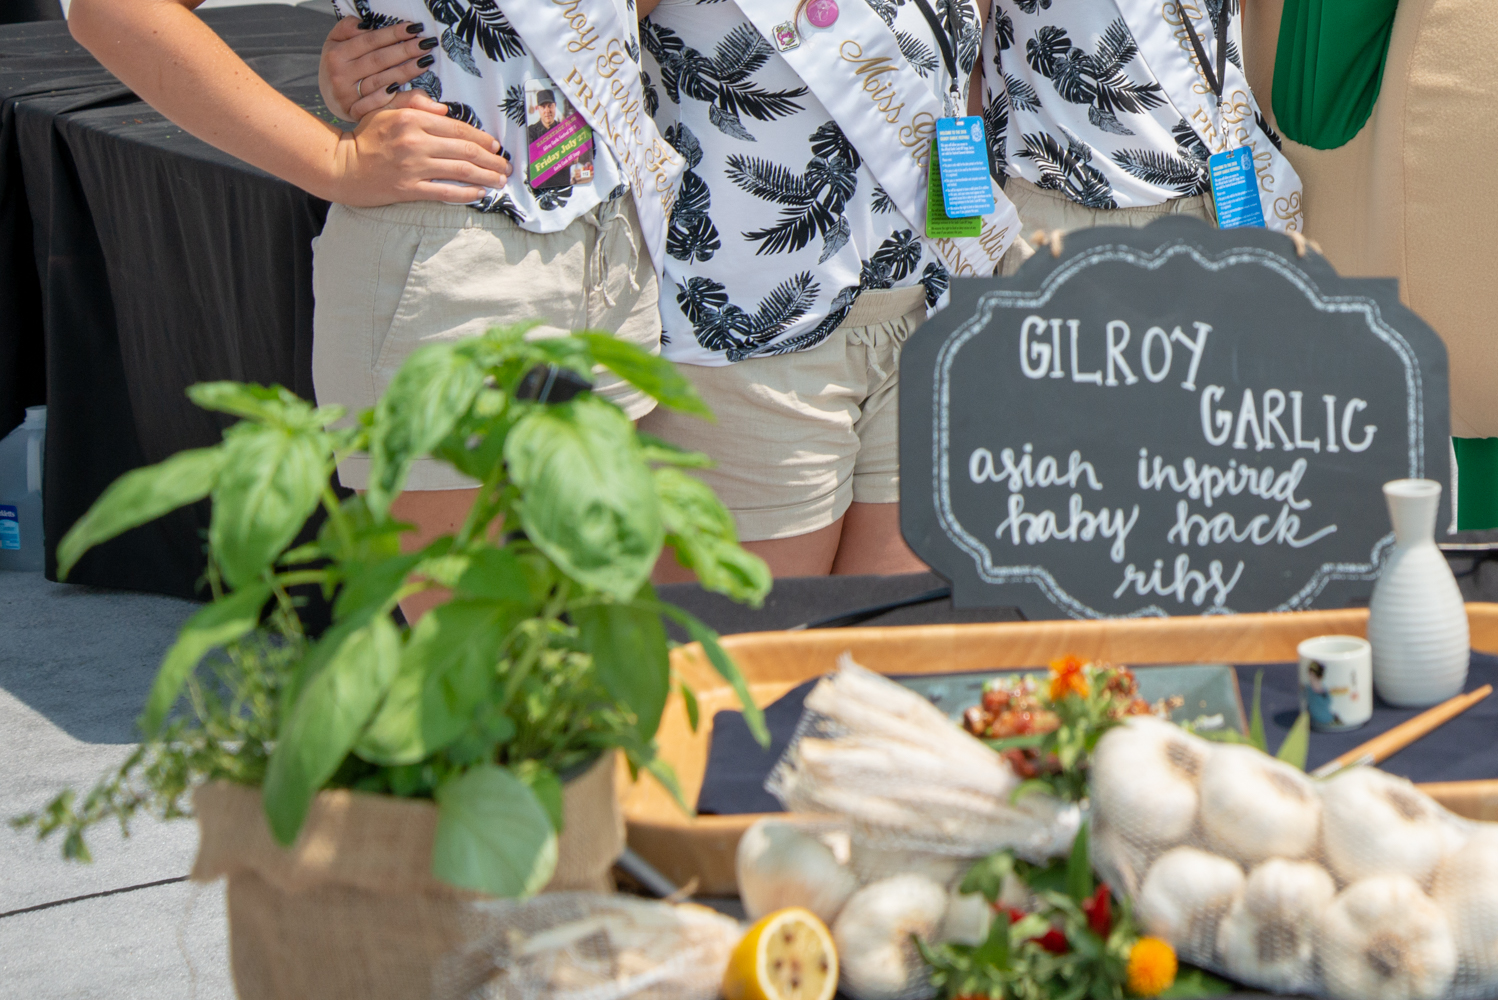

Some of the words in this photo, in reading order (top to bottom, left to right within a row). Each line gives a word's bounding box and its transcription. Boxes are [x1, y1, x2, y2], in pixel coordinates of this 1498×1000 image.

[596, 37, 644, 146] Garlic
[839, 40, 900, 124] Miss
[535, 150, 560, 172] Friday
[560, 137, 577, 154] July
[578, 130, 587, 141] 27
[563, 65, 644, 199] PRINCESS
[1019, 315, 1213, 392] GILROY
[1200, 384, 1378, 453] GARLIC
[969, 443, 1103, 493] asian
[1138, 447, 1312, 510] inspired
[996, 493, 1140, 563] baby
[1167, 500, 1338, 548] back
[1113, 553, 1245, 607] ribs
